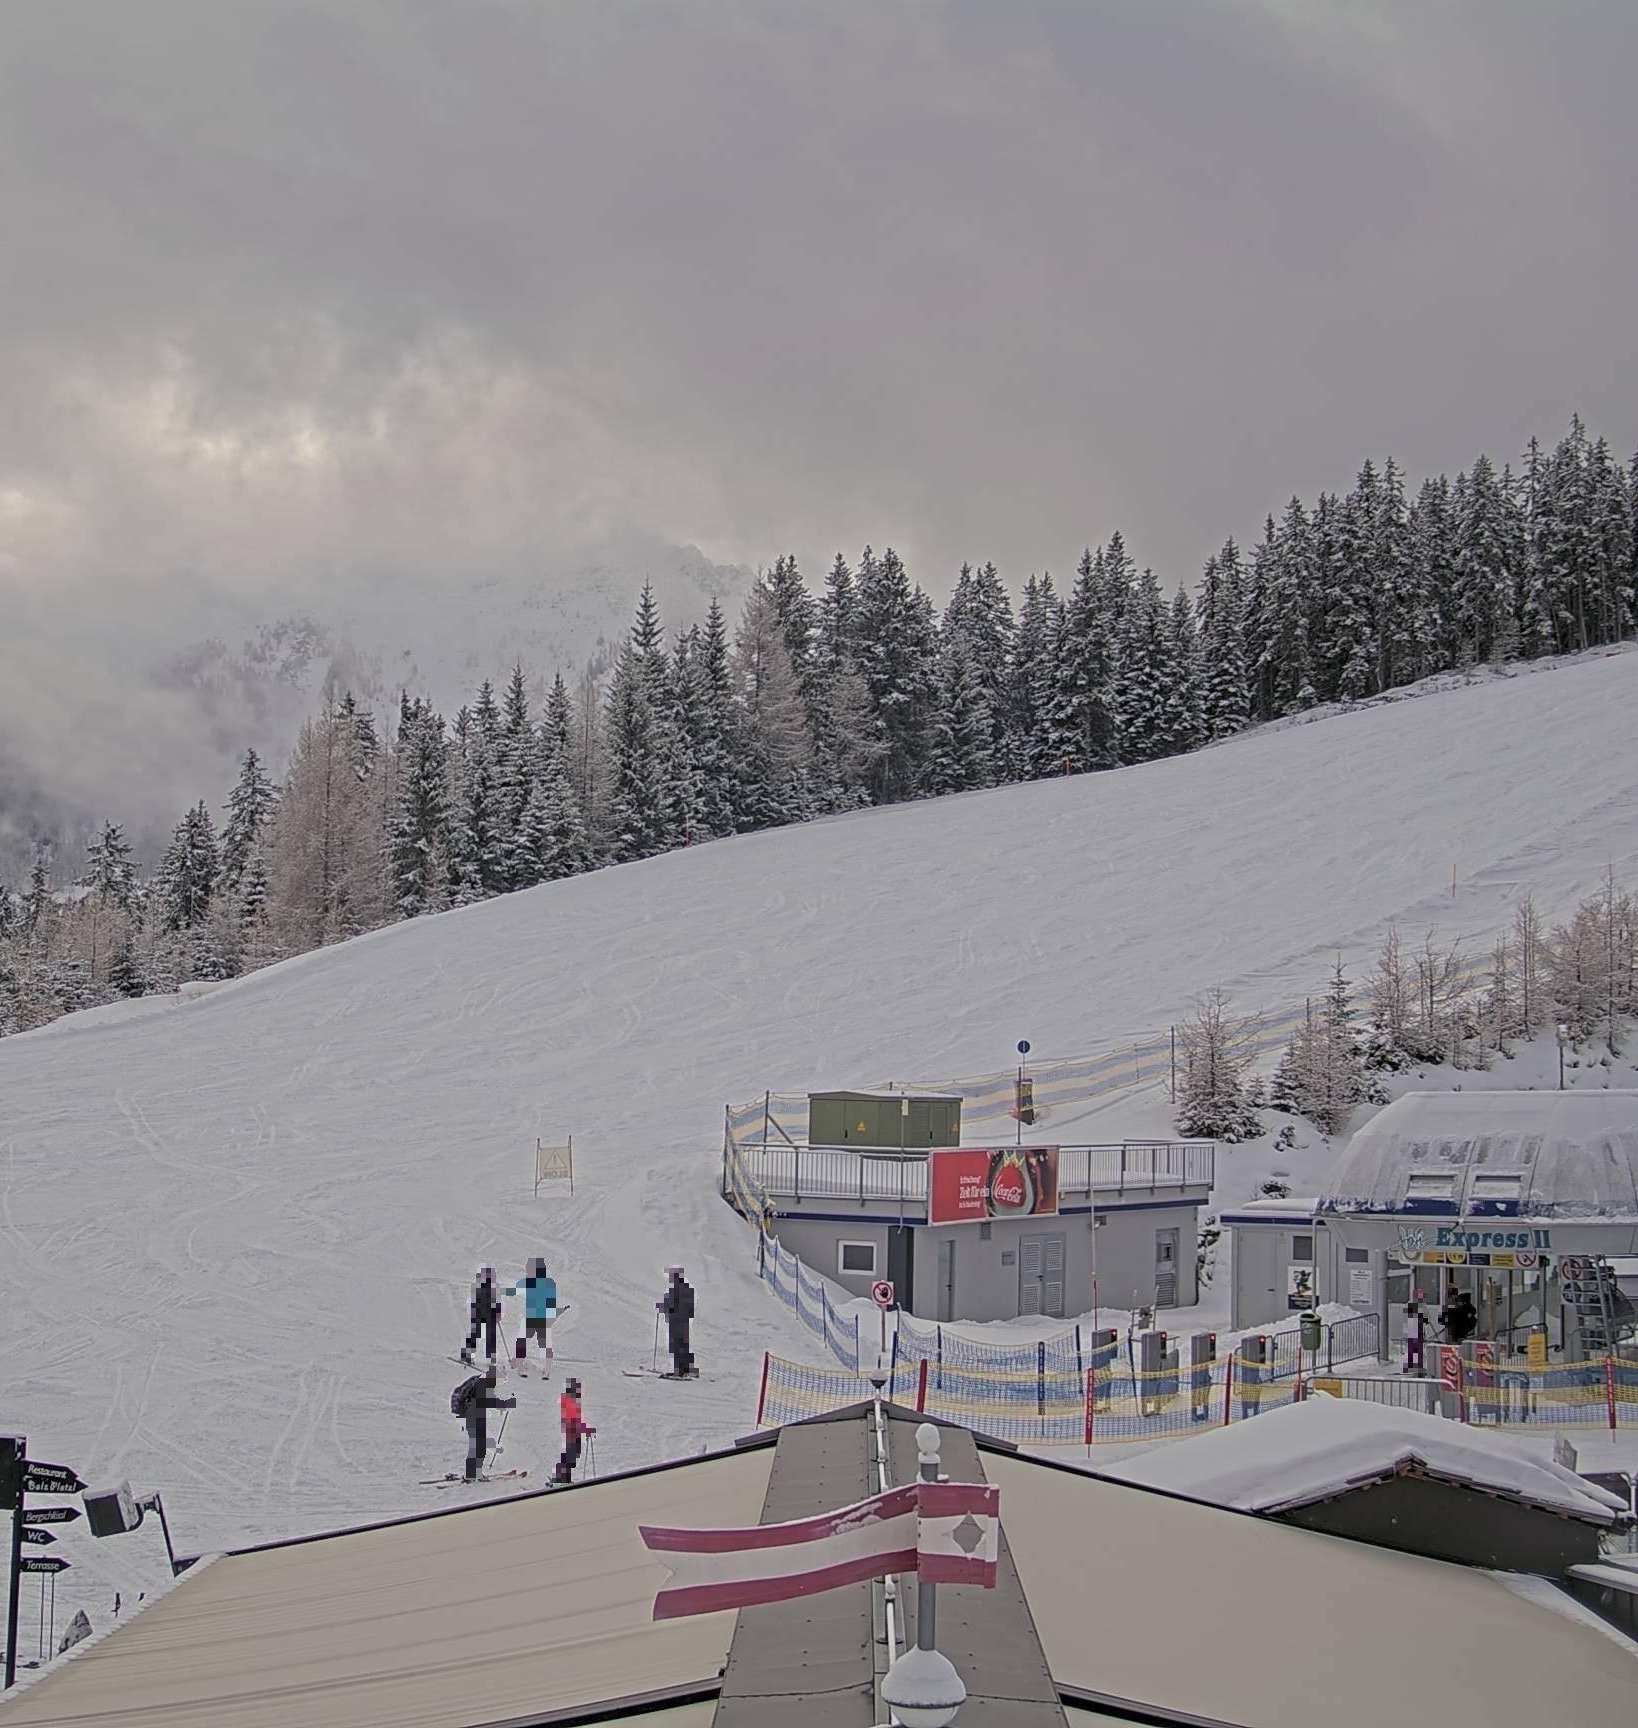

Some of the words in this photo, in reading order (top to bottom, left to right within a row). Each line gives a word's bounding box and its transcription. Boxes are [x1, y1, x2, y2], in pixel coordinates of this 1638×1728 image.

[1435, 1227, 1529, 1251] Express
[27, 1531, 46, 1542] WC
[26, 1560, 60, 1571] Terrasse
